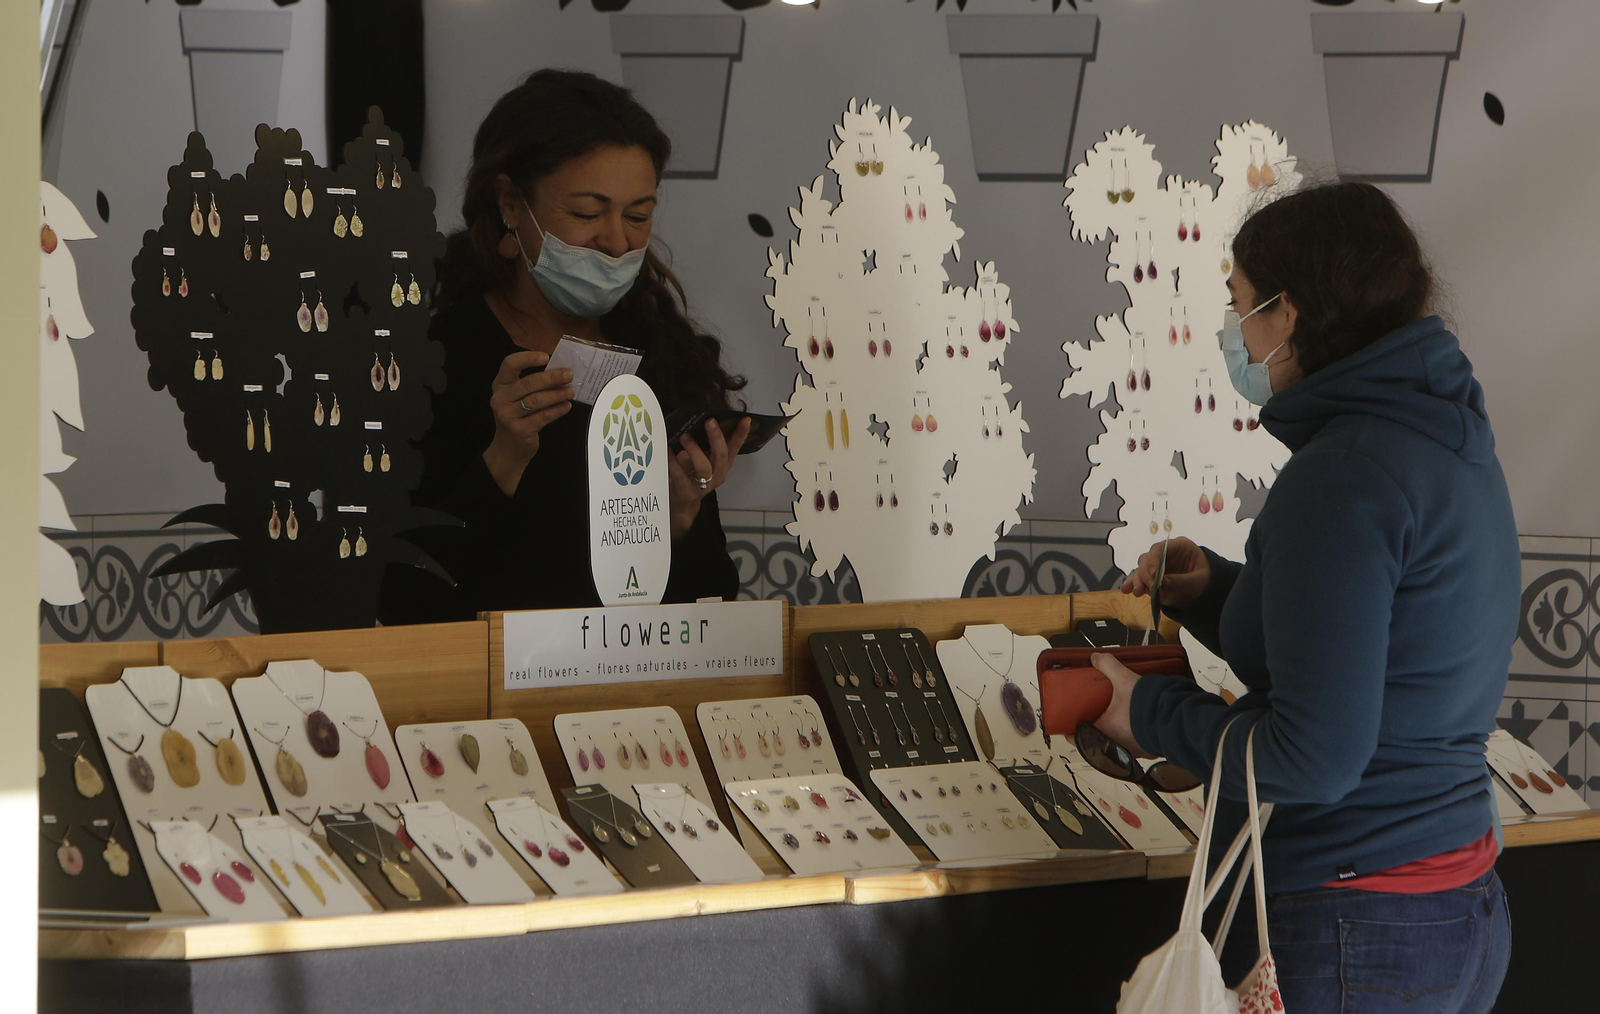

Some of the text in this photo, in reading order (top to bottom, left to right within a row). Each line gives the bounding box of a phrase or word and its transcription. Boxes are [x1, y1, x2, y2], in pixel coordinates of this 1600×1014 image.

[600, 493, 660, 516] ARTESANÍA
[613, 515, 648, 528] HECHA EN
[600, 524, 661, 547] ANDALUCÍA
[581, 615, 708, 649] flowear
[509, 667, 531, 681] real
[538, 666, 579, 679] flowers
[597, 662, 630, 675] flores
[636, 659, 688, 673] naturales
[705, 656, 738, 669] vraies
[744, 655, 776, 667] fleurs
